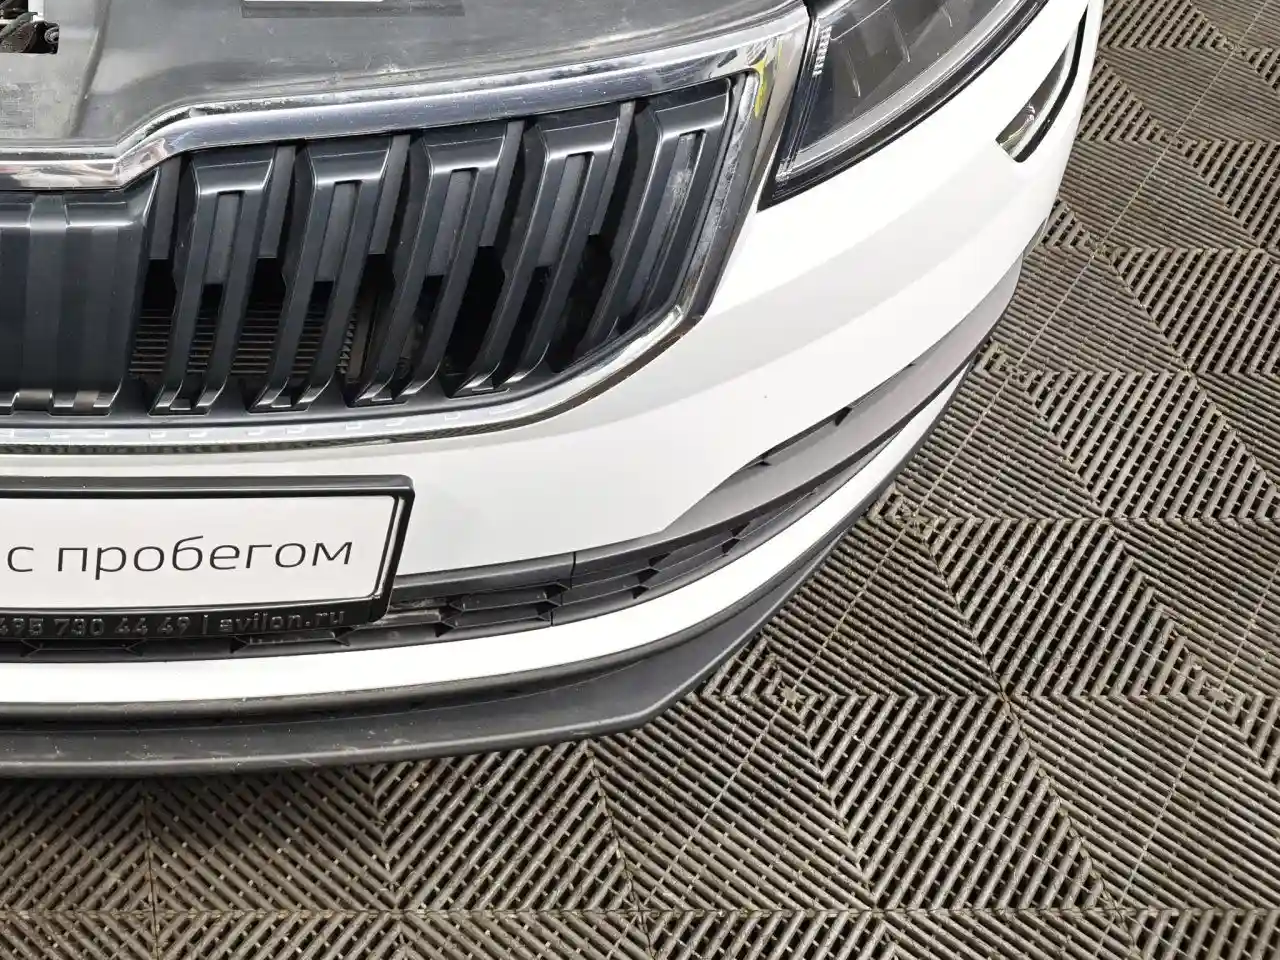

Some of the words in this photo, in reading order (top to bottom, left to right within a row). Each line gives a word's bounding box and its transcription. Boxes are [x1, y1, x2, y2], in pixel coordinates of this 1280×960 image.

[7, 546, 34, 573] с
[57, 535, 353, 581] пробегом
[54, 616, 105, 637] 730
[114, 616, 149, 636] 44
[157, 615, 192, 636] 49
[219, 610, 345, 633] avilon.ru
